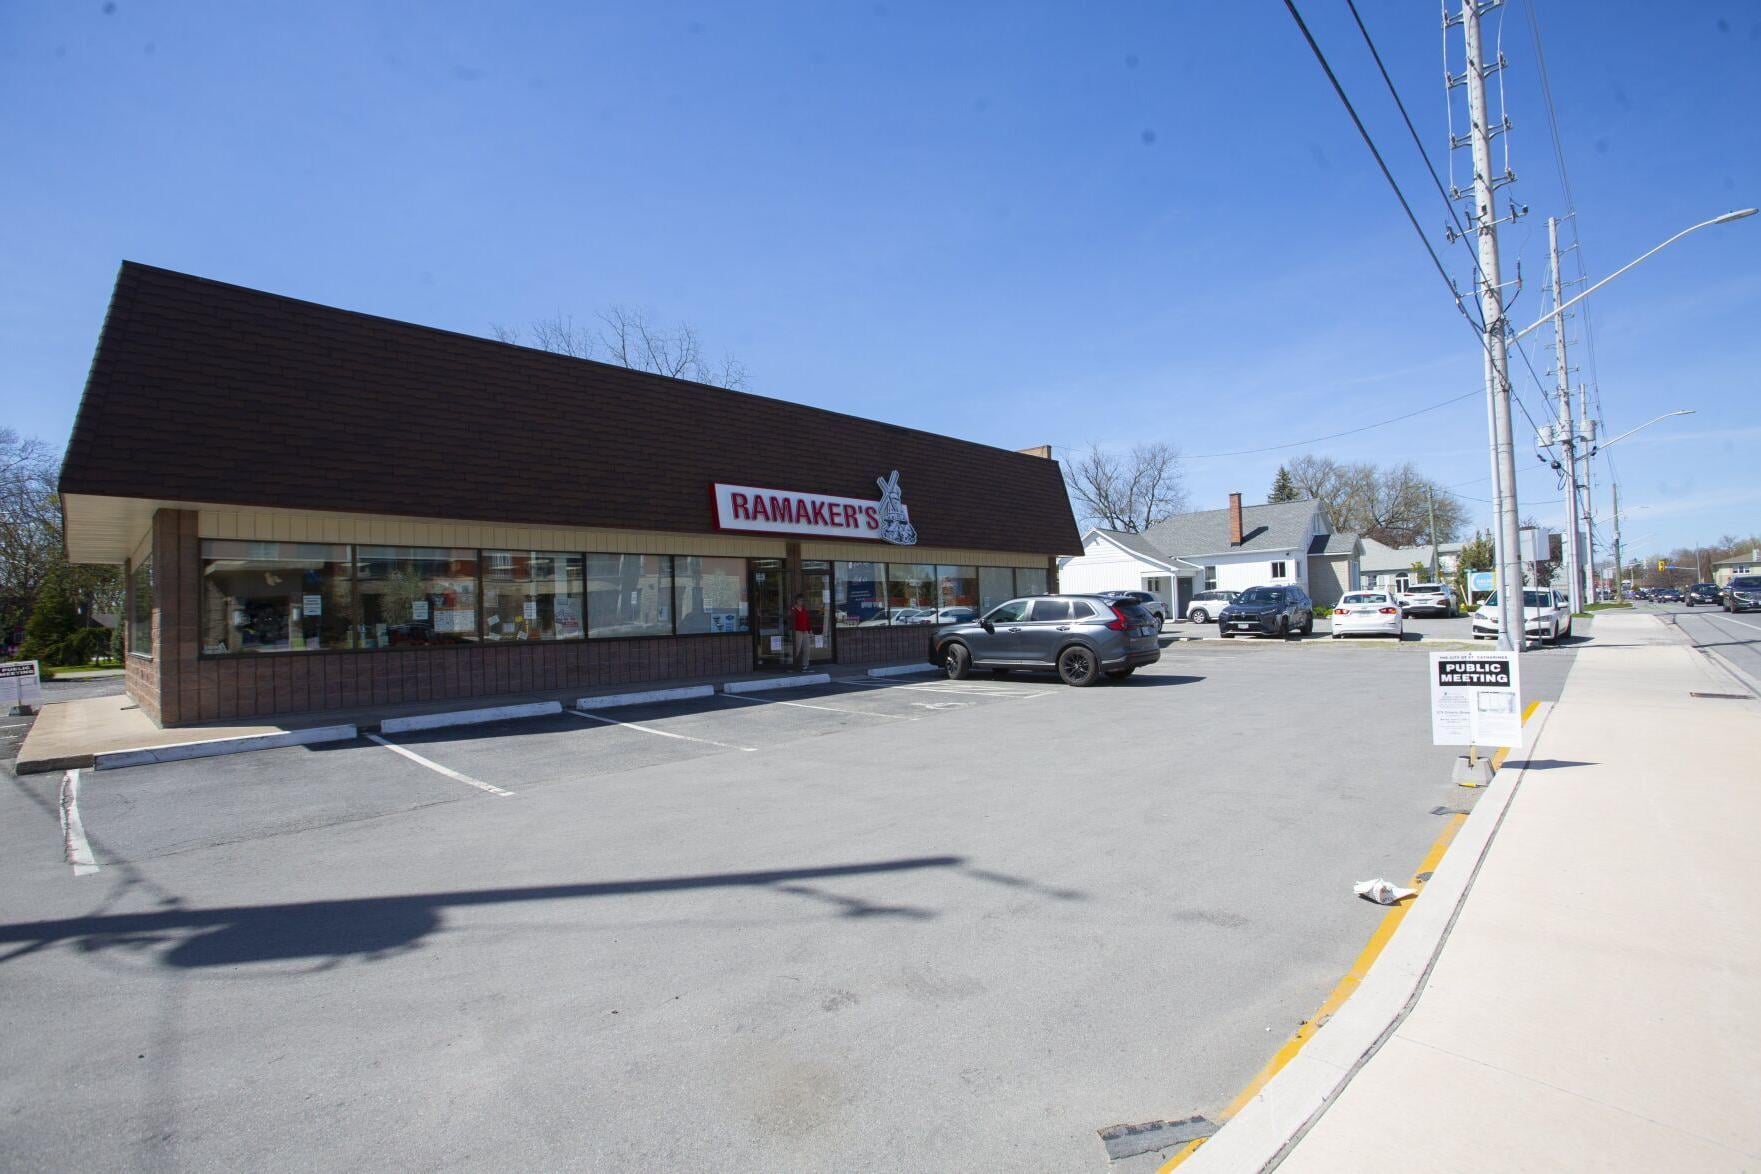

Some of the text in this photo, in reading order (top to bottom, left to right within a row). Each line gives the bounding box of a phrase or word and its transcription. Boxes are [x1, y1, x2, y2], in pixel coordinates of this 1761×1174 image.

[731, 492, 880, 530] RAMAKER'S
[1446, 664, 1500, 672] PUBLIC
[1441, 674, 1508, 682] MEETING
